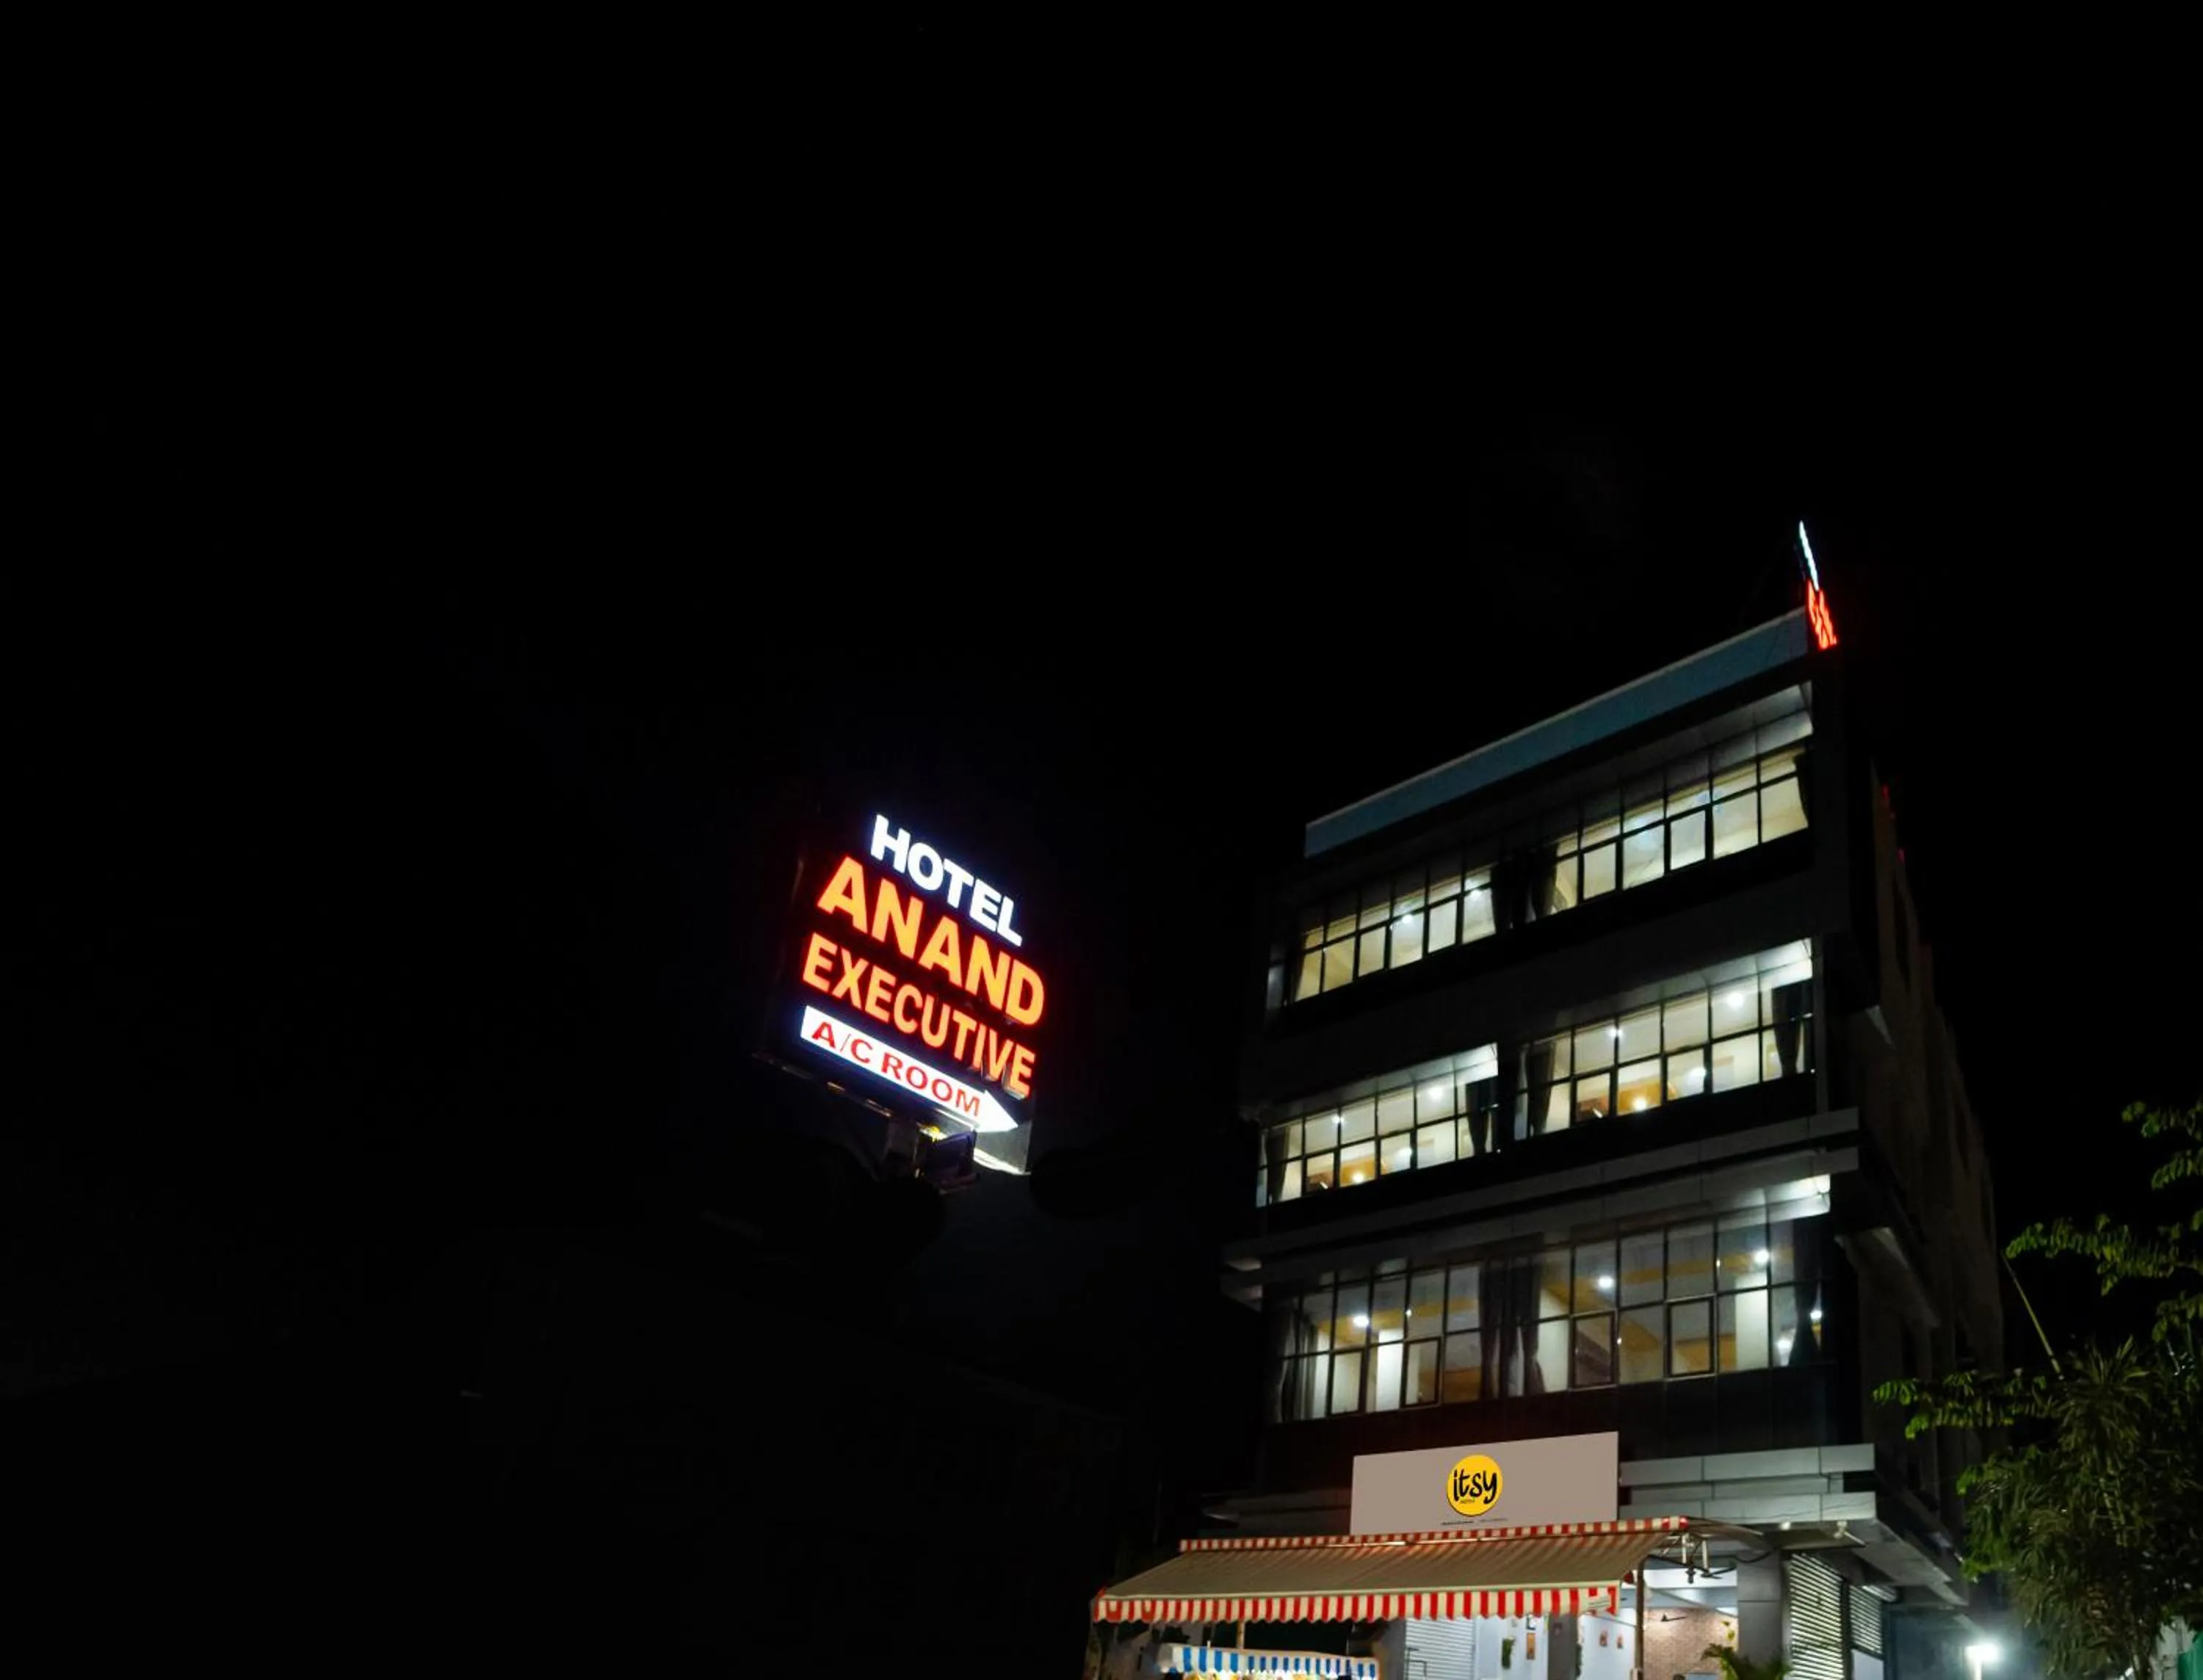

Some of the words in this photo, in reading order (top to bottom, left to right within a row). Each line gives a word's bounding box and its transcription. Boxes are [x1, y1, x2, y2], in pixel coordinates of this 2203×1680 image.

[817, 855, 1046, 1026] ANAND
[870, 814, 1023, 947] HOTEL
[802, 932, 1036, 1099] EXECUTIVE
[811, 1021, 875, 1064] A/C
[880, 1054, 980, 1118] ROOM
[1453, 1468, 1497, 1505] itsy
